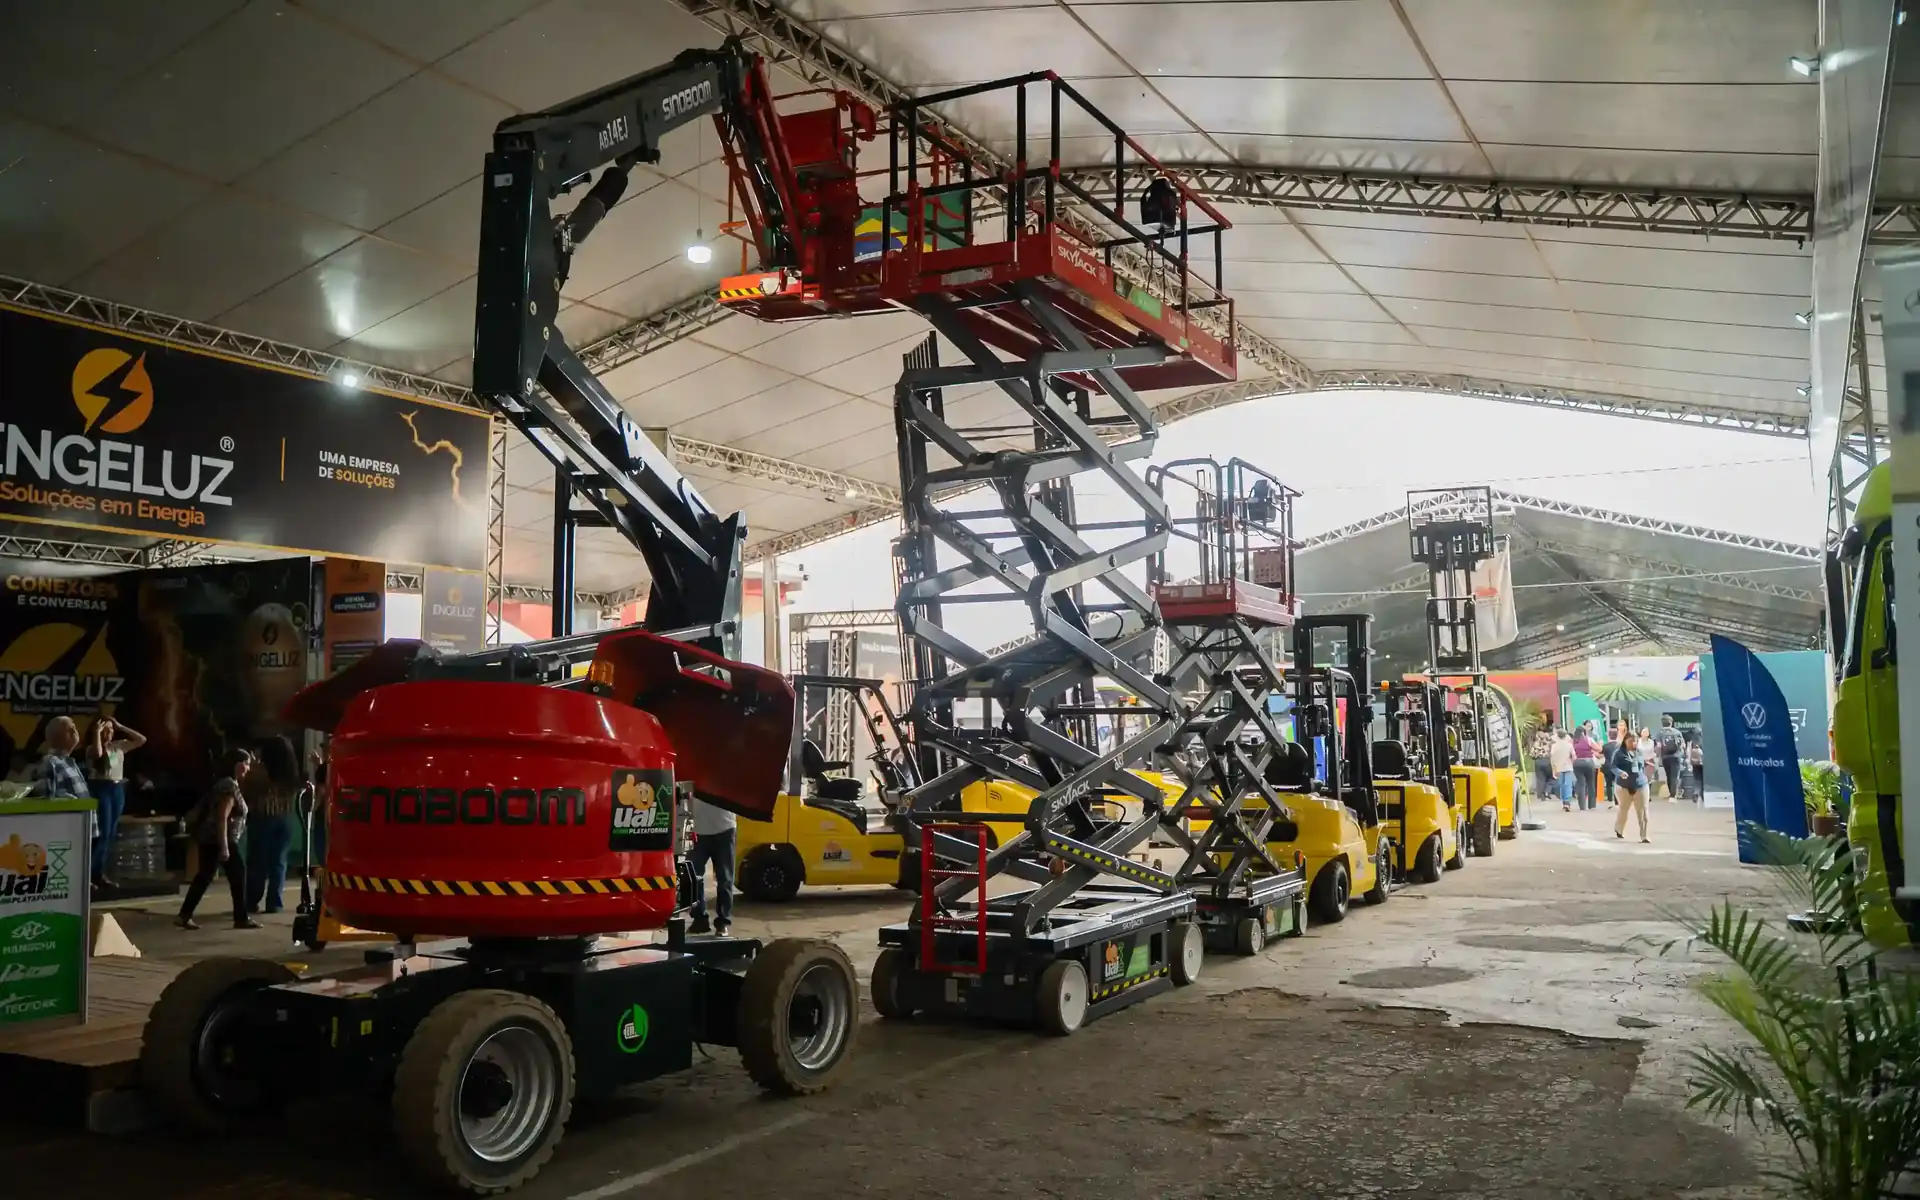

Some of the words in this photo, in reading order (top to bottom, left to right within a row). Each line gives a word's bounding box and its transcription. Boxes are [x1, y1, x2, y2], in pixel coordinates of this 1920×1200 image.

[662, 80, 713, 121] SINOBOOM
[598, 115, 629, 151] AB14EJ
[1057, 245, 1097, 278] SKYJACK
[0, 422, 234, 506] NGELUZ
[318, 465, 334, 478] DE
[335, 469, 395, 488] SOLUÇÕES
[319, 450, 347, 466] UMA
[349, 455, 400, 475] EMPRESA
[0, 480, 96, 511] Soluções
[101, 499, 132, 514] em
[138, 500, 205, 527] Energia
[6, 575, 119, 598] CONEXÕES
[17, 594, 26, 605] E
[29, 595, 108, 611] CONVERSAS
[1051, 780, 1091, 813] SKYJACK
[628, 827, 669, 835] PLATAFORMAS
[12, 892, 68, 904] PLATAFORMAS
